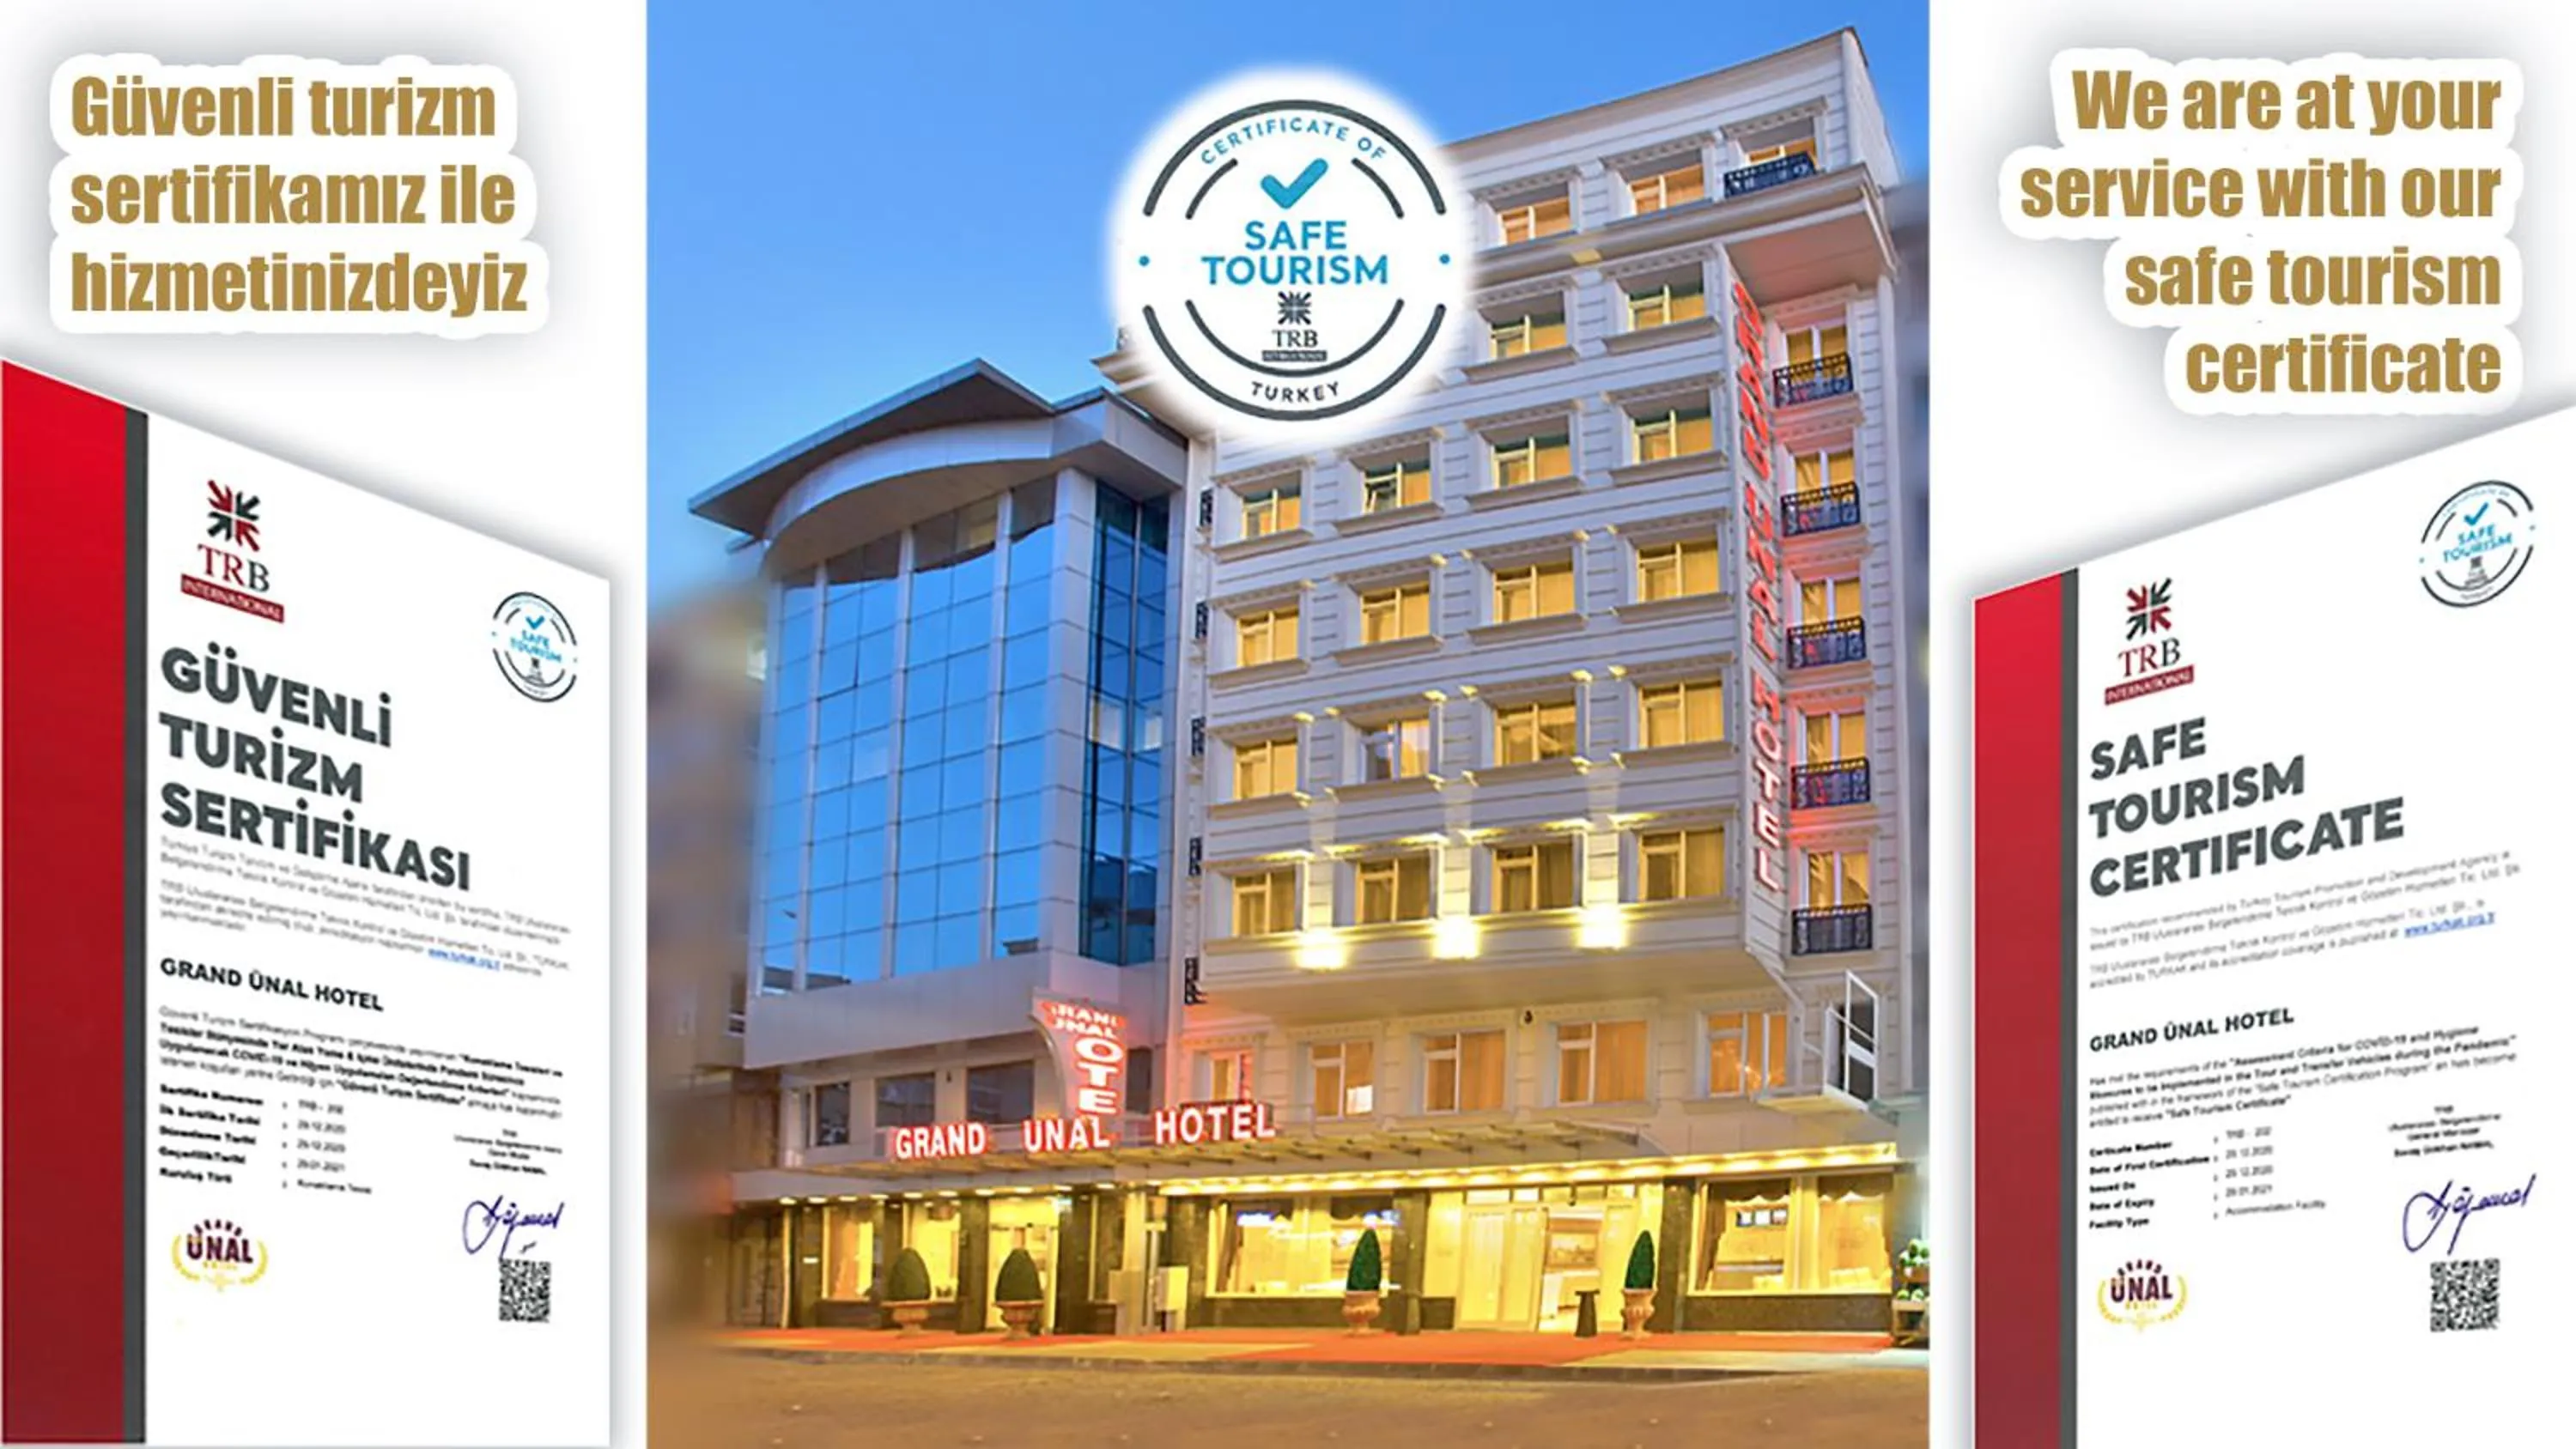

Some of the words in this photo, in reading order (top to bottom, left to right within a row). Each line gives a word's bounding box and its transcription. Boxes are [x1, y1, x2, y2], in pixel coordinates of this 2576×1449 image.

[197, 543, 270, 592] TRB
[161, 641, 392, 748] GÜVENLİ
[2117, 637, 2181, 677] TRB
[158, 712, 362, 803] TURİZM
[1753, 672, 1782, 891] HOTEL
[2091, 716, 2206, 780] SAFE
[161, 782, 470, 892] SERTİFİKASI
[2089, 754, 2305, 839] TOURISM
[2090, 796, 2404, 897] CERTIFICATE
[161, 957, 242, 986] GRAND
[249, 968, 309, 998] ÜNAL
[315, 984, 383, 1012] HOTEL
[2089, 1028, 2158, 1052] GRAND
[2164, 1019, 2219, 1041] ÜNAL
[2225, 1008, 2294, 1032] HOTEL
[1076, 1037, 1123, 1118] OTE
[896, 1122, 986, 1160] GRAND
[1024, 1116, 1110, 1154] UNAL
[1155, 1103, 1275, 1144] HOTEL
